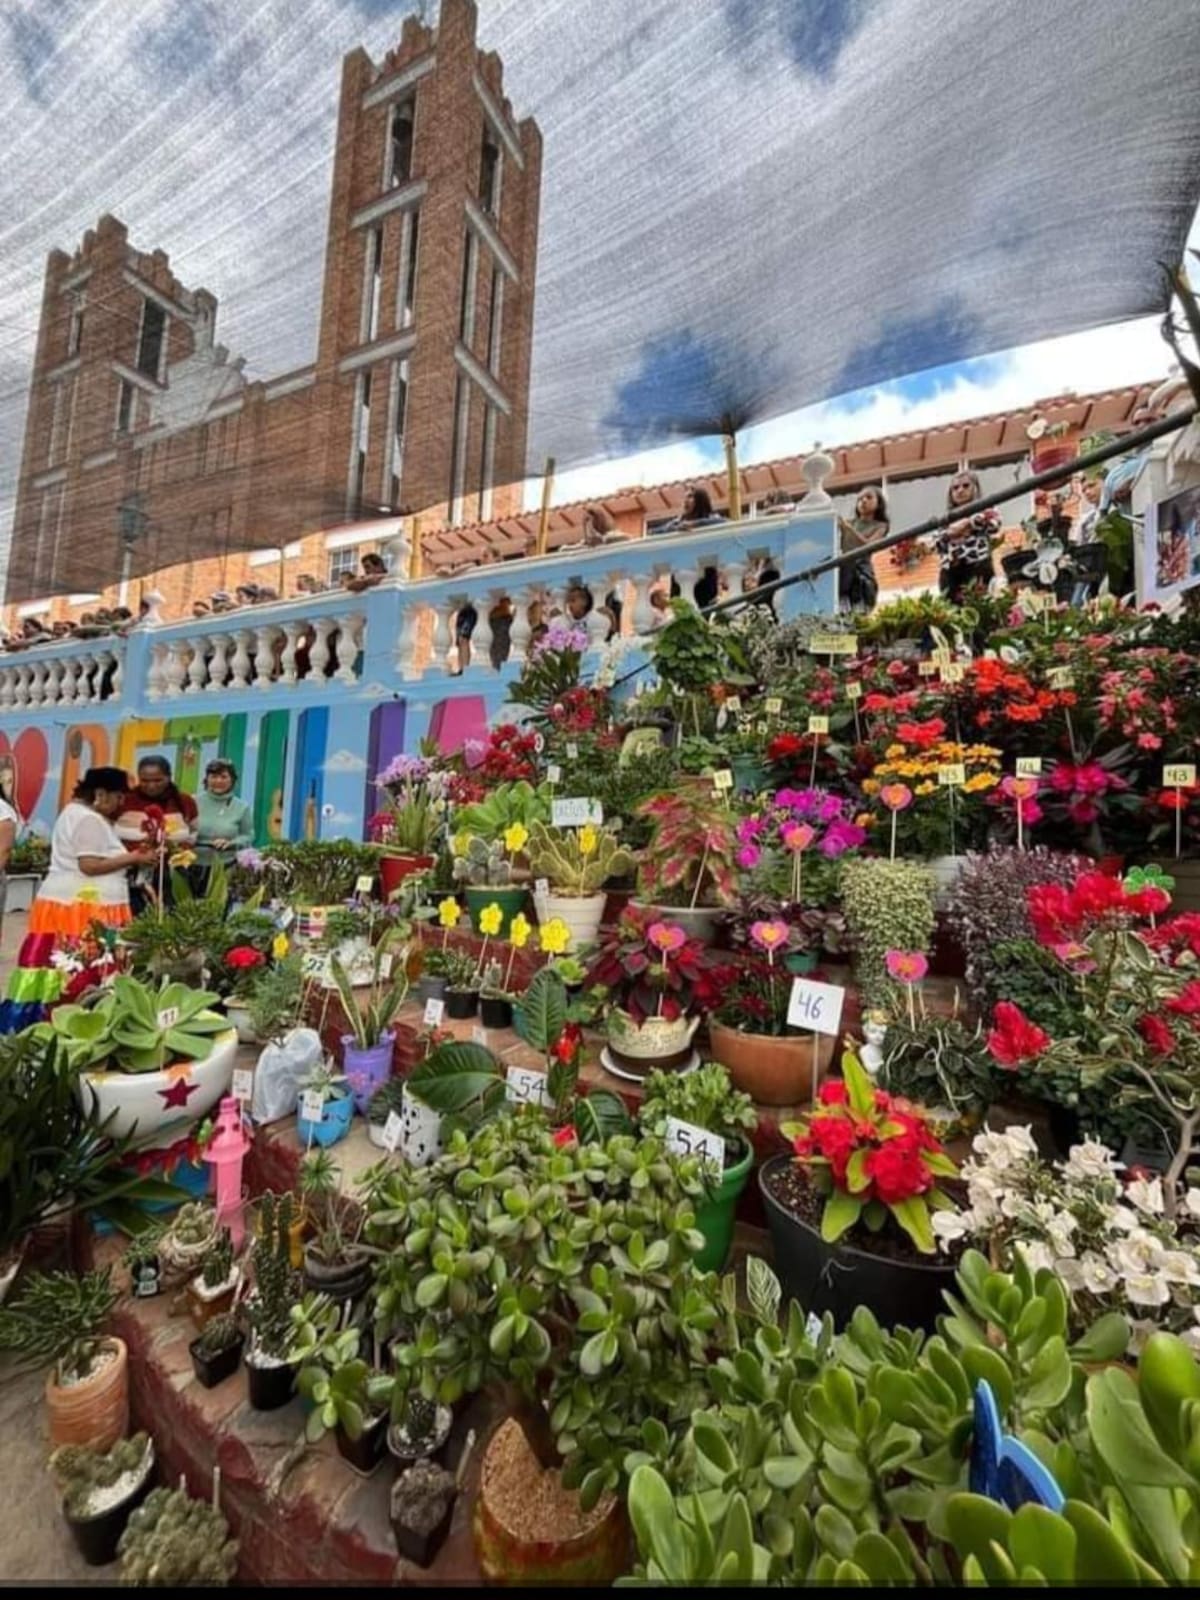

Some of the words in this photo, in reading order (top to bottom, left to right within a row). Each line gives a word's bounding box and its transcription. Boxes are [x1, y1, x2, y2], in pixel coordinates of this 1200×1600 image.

[57, 695, 488, 846] BTULI
[798, 990, 825, 1020] 46
[515, 1075, 546, 1105] 54
[676, 1128, 712, 1164] 54
